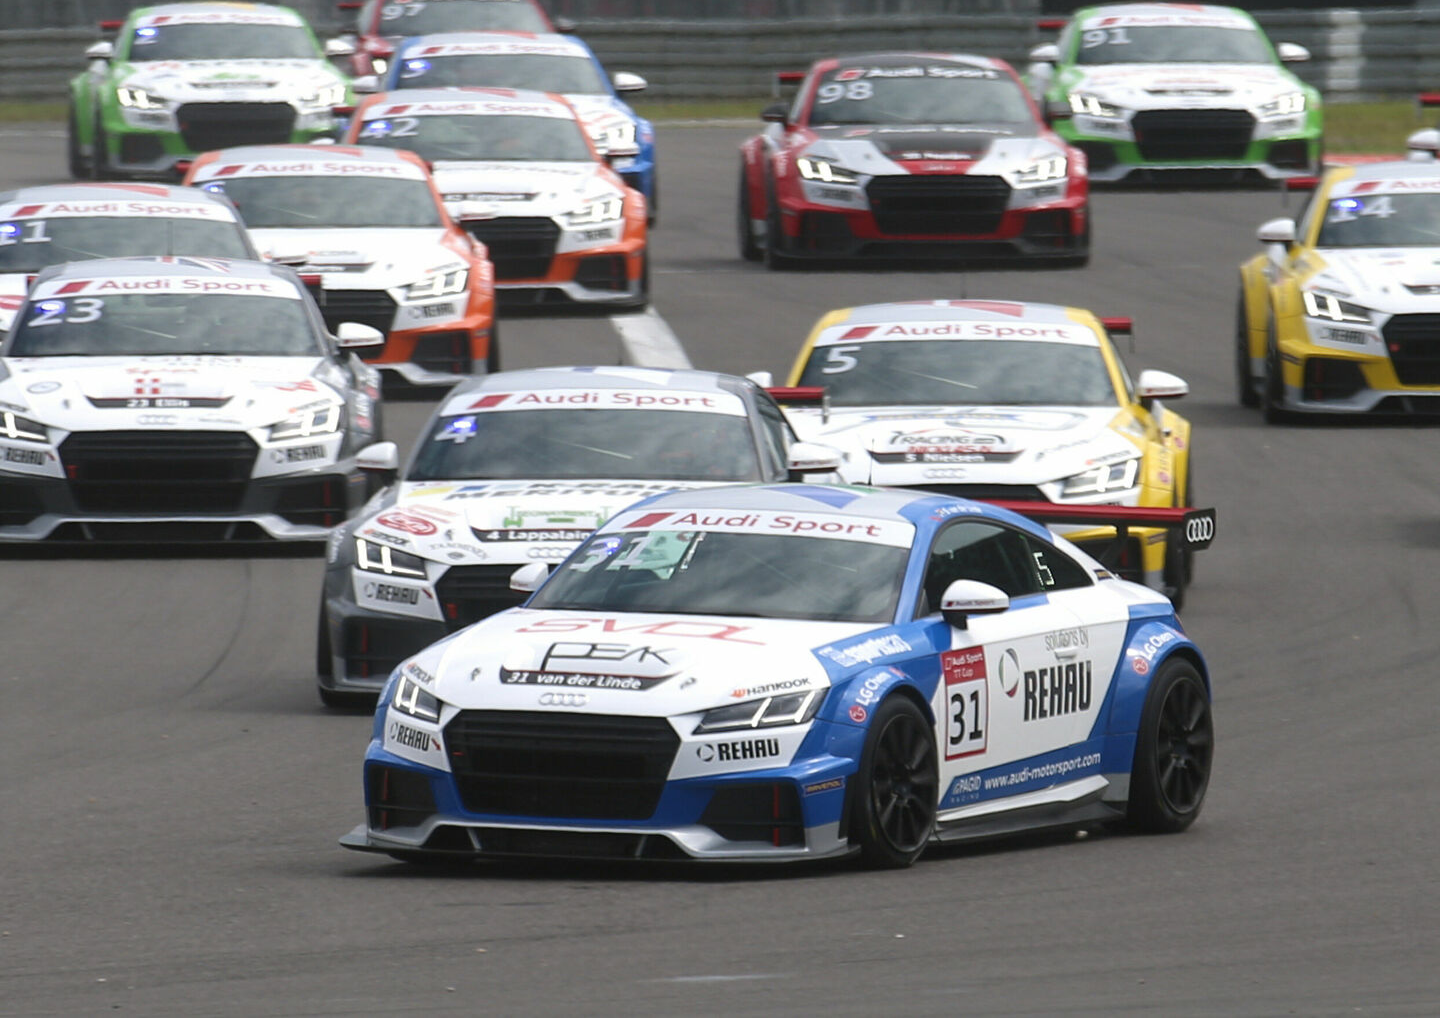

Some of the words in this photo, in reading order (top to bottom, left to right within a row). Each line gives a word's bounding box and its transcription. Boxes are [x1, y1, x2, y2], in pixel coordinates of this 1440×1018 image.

[382, 4, 427, 21] 97
[1082, 28, 1132, 49] 91
[866, 67, 924, 78] Audi
[927, 67, 1000, 79] Sport
[817, 82, 874, 104] 98
[251, 163, 311, 174] Audi
[316, 163, 401, 176] Sport
[50, 204, 119, 214] Audi
[126, 203, 208, 216] Sport
[98, 280, 177, 291] Audi
[184, 280, 273, 293] Sport
[28, 297, 106, 328] 23
[883, 324, 961, 337] Audi
[974, 324, 1070, 340] Sport
[821, 346, 861, 375] 5
[517, 393, 599, 405] Audi
[613, 393, 715, 408] Sport
[487, 530, 500, 540] 4
[673, 513, 761, 528] Audi
[768, 515, 883, 538] Sport
[376, 584, 420, 604] REHAU
[952, 655, 965, 666] Audi
[966, 652, 983, 664] Sport
[507, 671, 528, 684] 31
[537, 674, 564, 685] van
[567, 673, 595, 687] der
[597, 674, 642, 689] Linde
[1023, 659, 1092, 723] REHAU
[950, 689, 983, 746] 31
[396, 725, 431, 752] REHAU
[718, 738, 780, 761] REHAU
[984, 751, 1101, 790] www.audi-motorsport.com
[959, 775, 982, 793] PAGID
